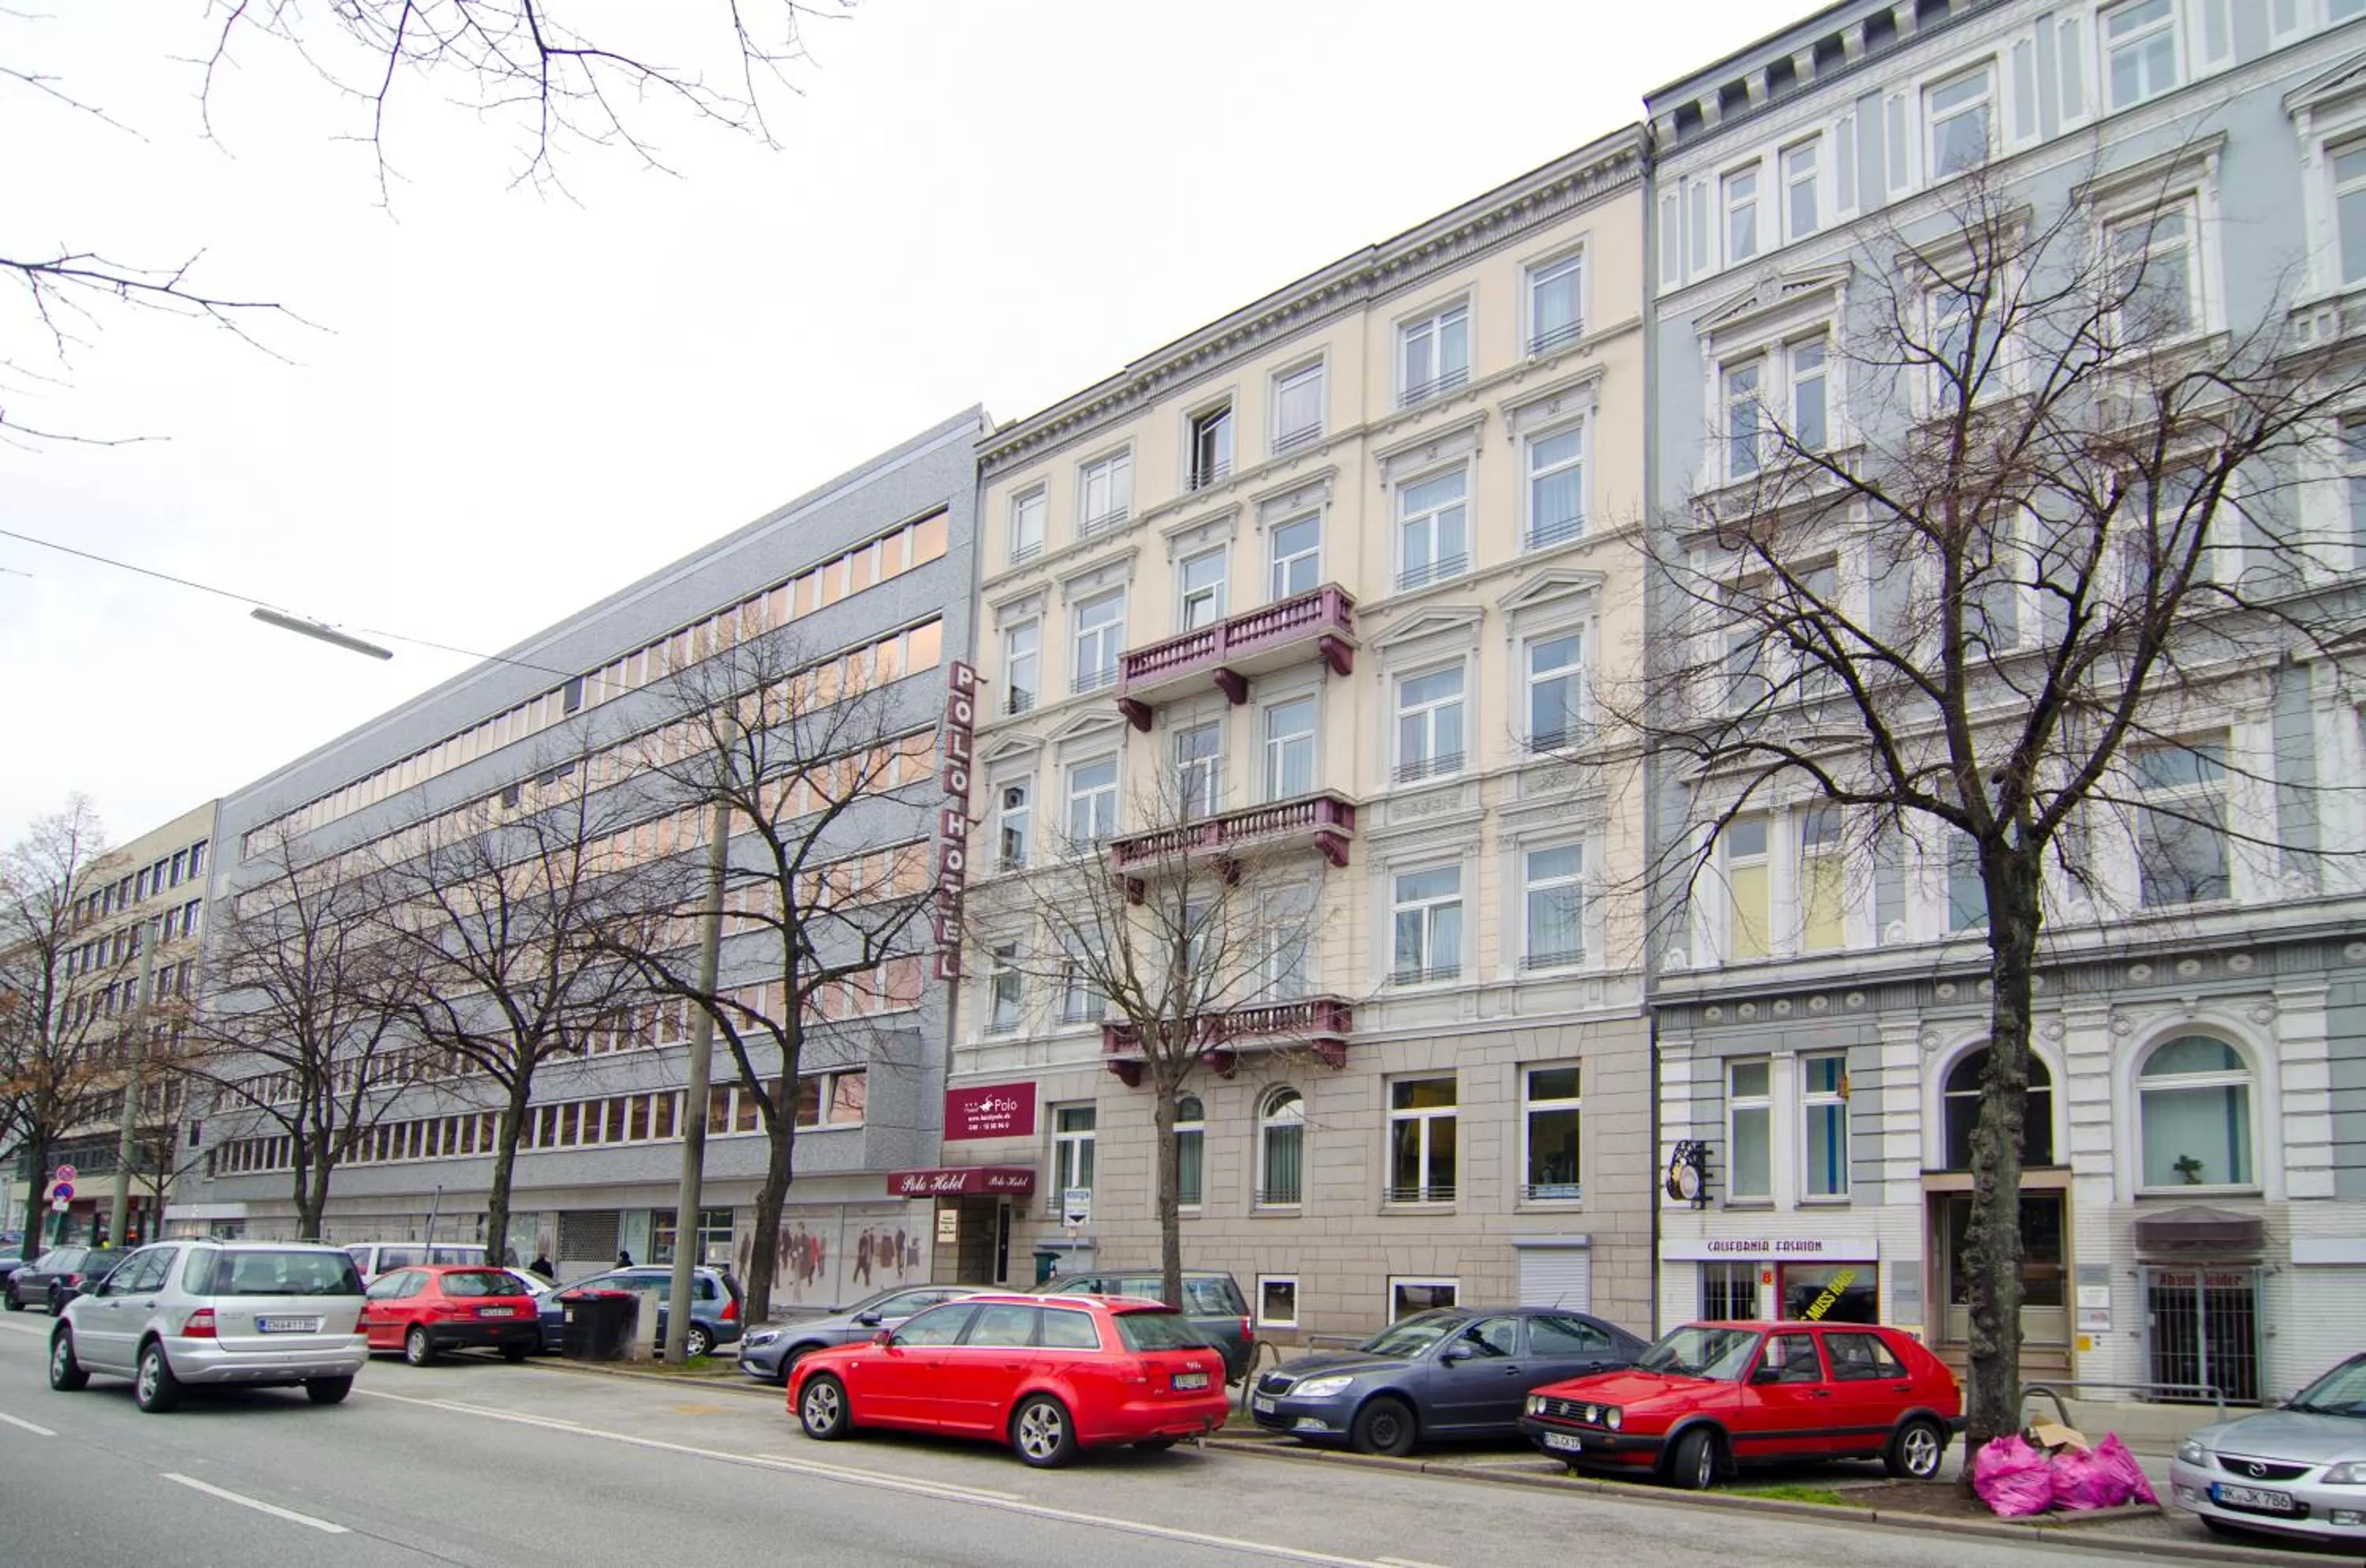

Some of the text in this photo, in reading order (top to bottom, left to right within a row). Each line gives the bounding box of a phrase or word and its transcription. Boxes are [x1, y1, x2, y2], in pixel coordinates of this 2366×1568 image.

[941, 666, 973, 976] POLO HOTEL
[994, 1097, 1018, 1112] Polo
[901, 1173, 967, 1192] Polo Hotel
[988, 1176, 1028, 1187] Polo Hotel
[1707, 1241, 1823, 1253] CALIFORNIA FASHION
[1806, 1290, 1836, 1321] MUSS
